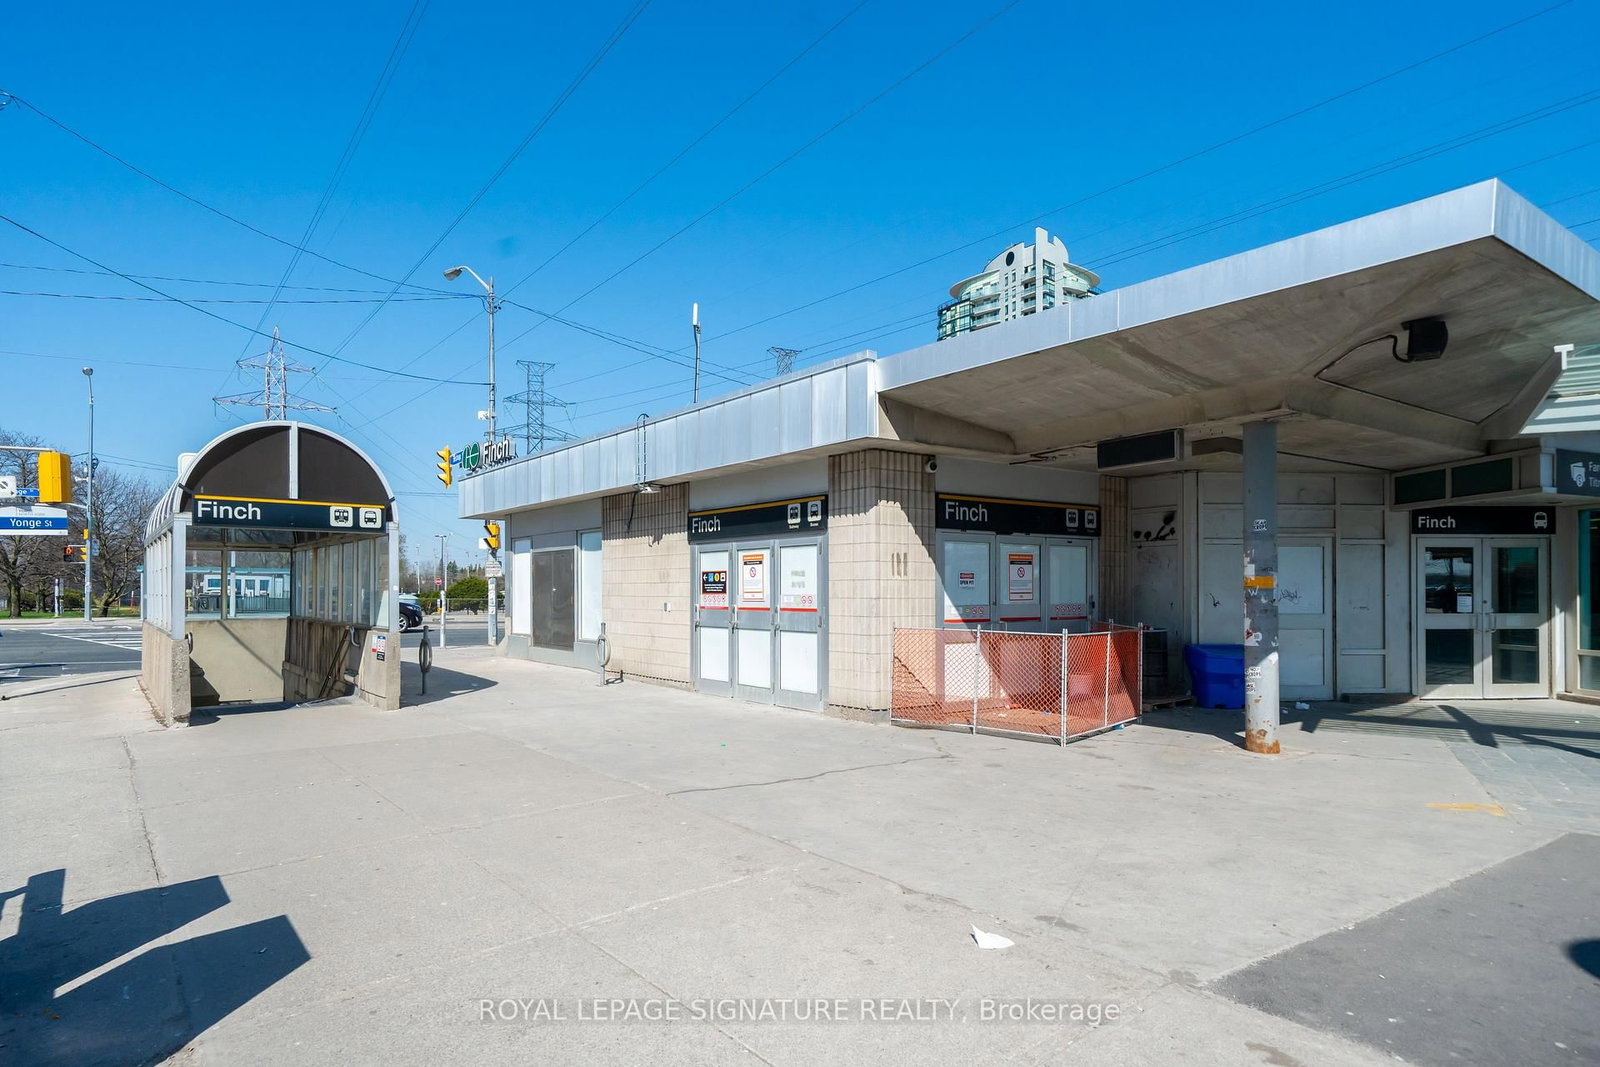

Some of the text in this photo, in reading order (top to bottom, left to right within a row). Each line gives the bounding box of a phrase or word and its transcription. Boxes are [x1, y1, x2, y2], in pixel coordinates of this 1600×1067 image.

[483, 435, 510, 466] Finch
[197, 500, 262, 521] Finch
[944, 501, 989, 522] Finch
[10, 518, 53, 529] Yonge St
[692, 516, 721, 534] Finch
[1417, 515, 1456, 529] Finch
